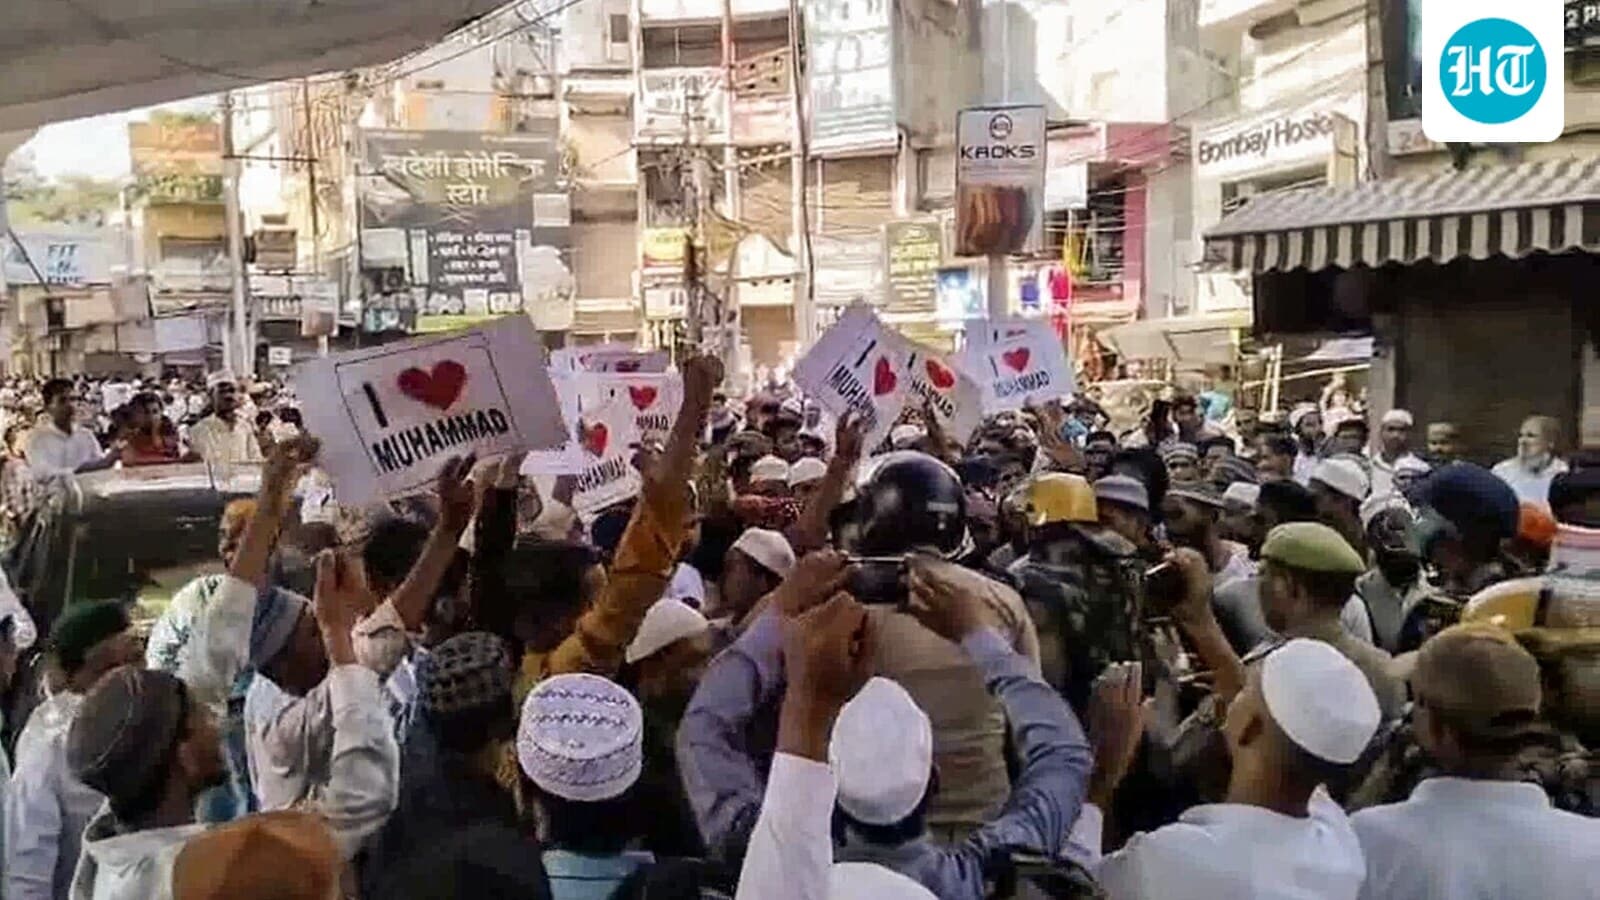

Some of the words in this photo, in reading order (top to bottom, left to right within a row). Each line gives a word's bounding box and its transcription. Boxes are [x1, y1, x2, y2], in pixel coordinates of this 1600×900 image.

[1199, 129, 1271, 165] Bombay
[362, 382, 389, 428] I
[372, 408, 510, 475] MUHAMMAD
